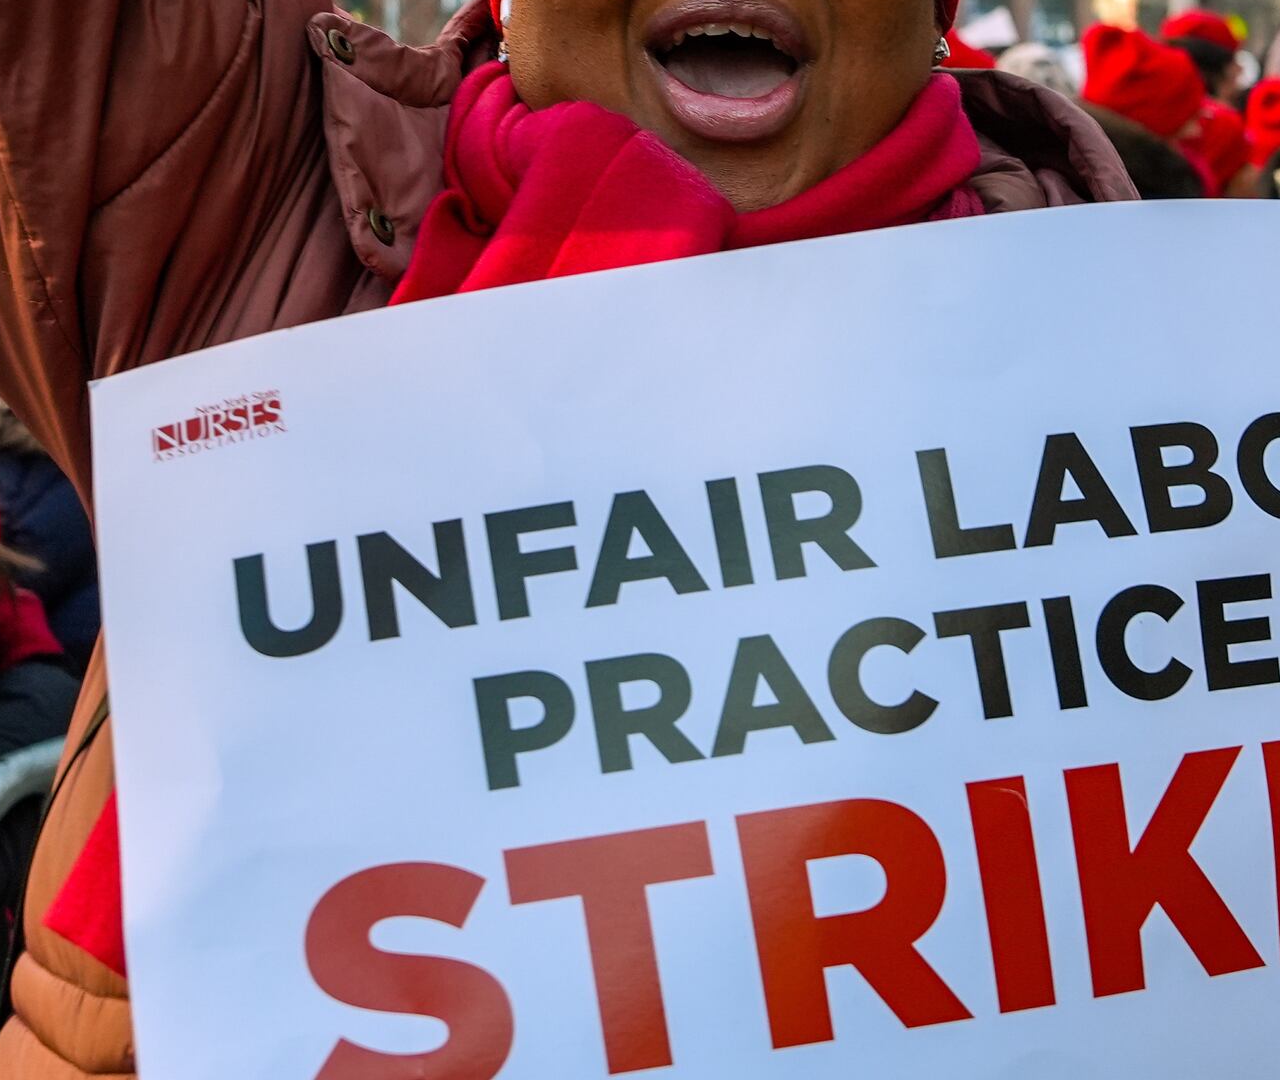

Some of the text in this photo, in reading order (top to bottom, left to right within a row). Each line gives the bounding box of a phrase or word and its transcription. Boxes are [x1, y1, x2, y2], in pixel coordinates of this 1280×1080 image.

[152, 398, 283, 453] NURSES
[196, 388, 280, 415] New York State
[153, 421, 289, 463] ASSOCIATION
[234, 465, 877, 658] UNFAIR
